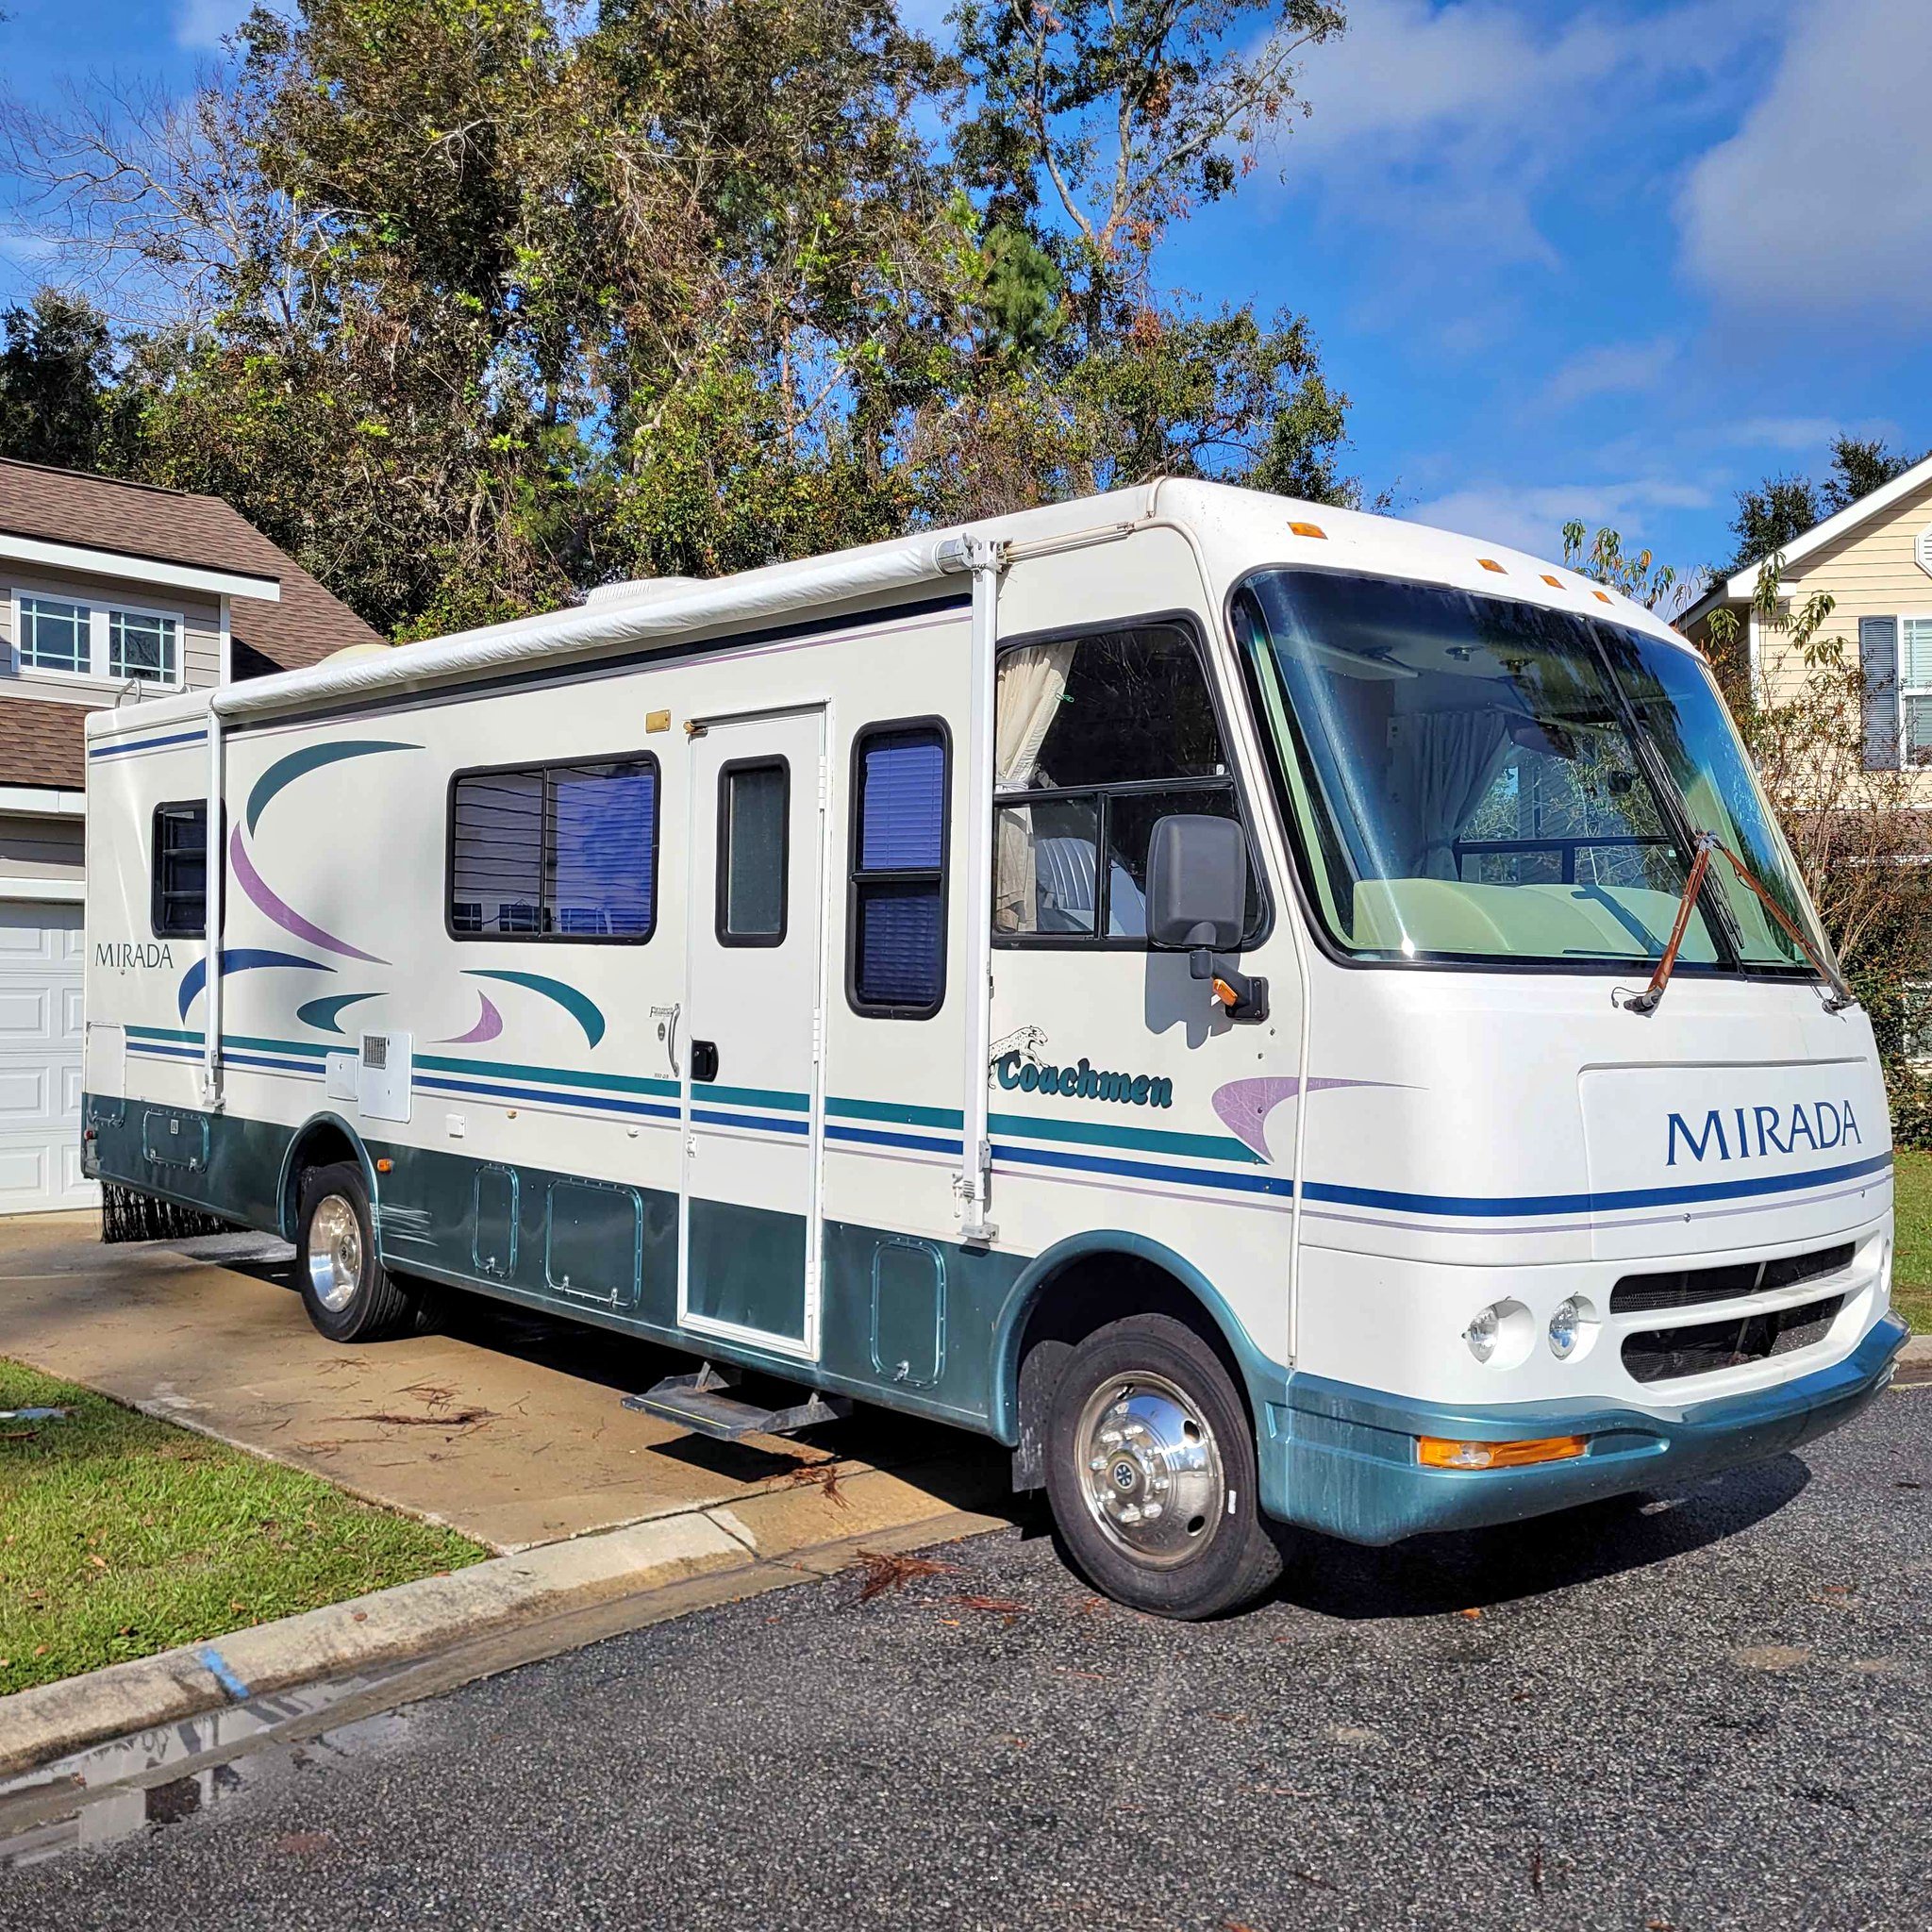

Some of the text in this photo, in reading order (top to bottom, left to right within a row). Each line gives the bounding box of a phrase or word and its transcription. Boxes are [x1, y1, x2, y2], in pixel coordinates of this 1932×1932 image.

[95, 943, 174, 969] MIRADA
[998, 1050, 1173, 1108] Coachmen
[1665, 1100, 1862, 1166] MIRADA
